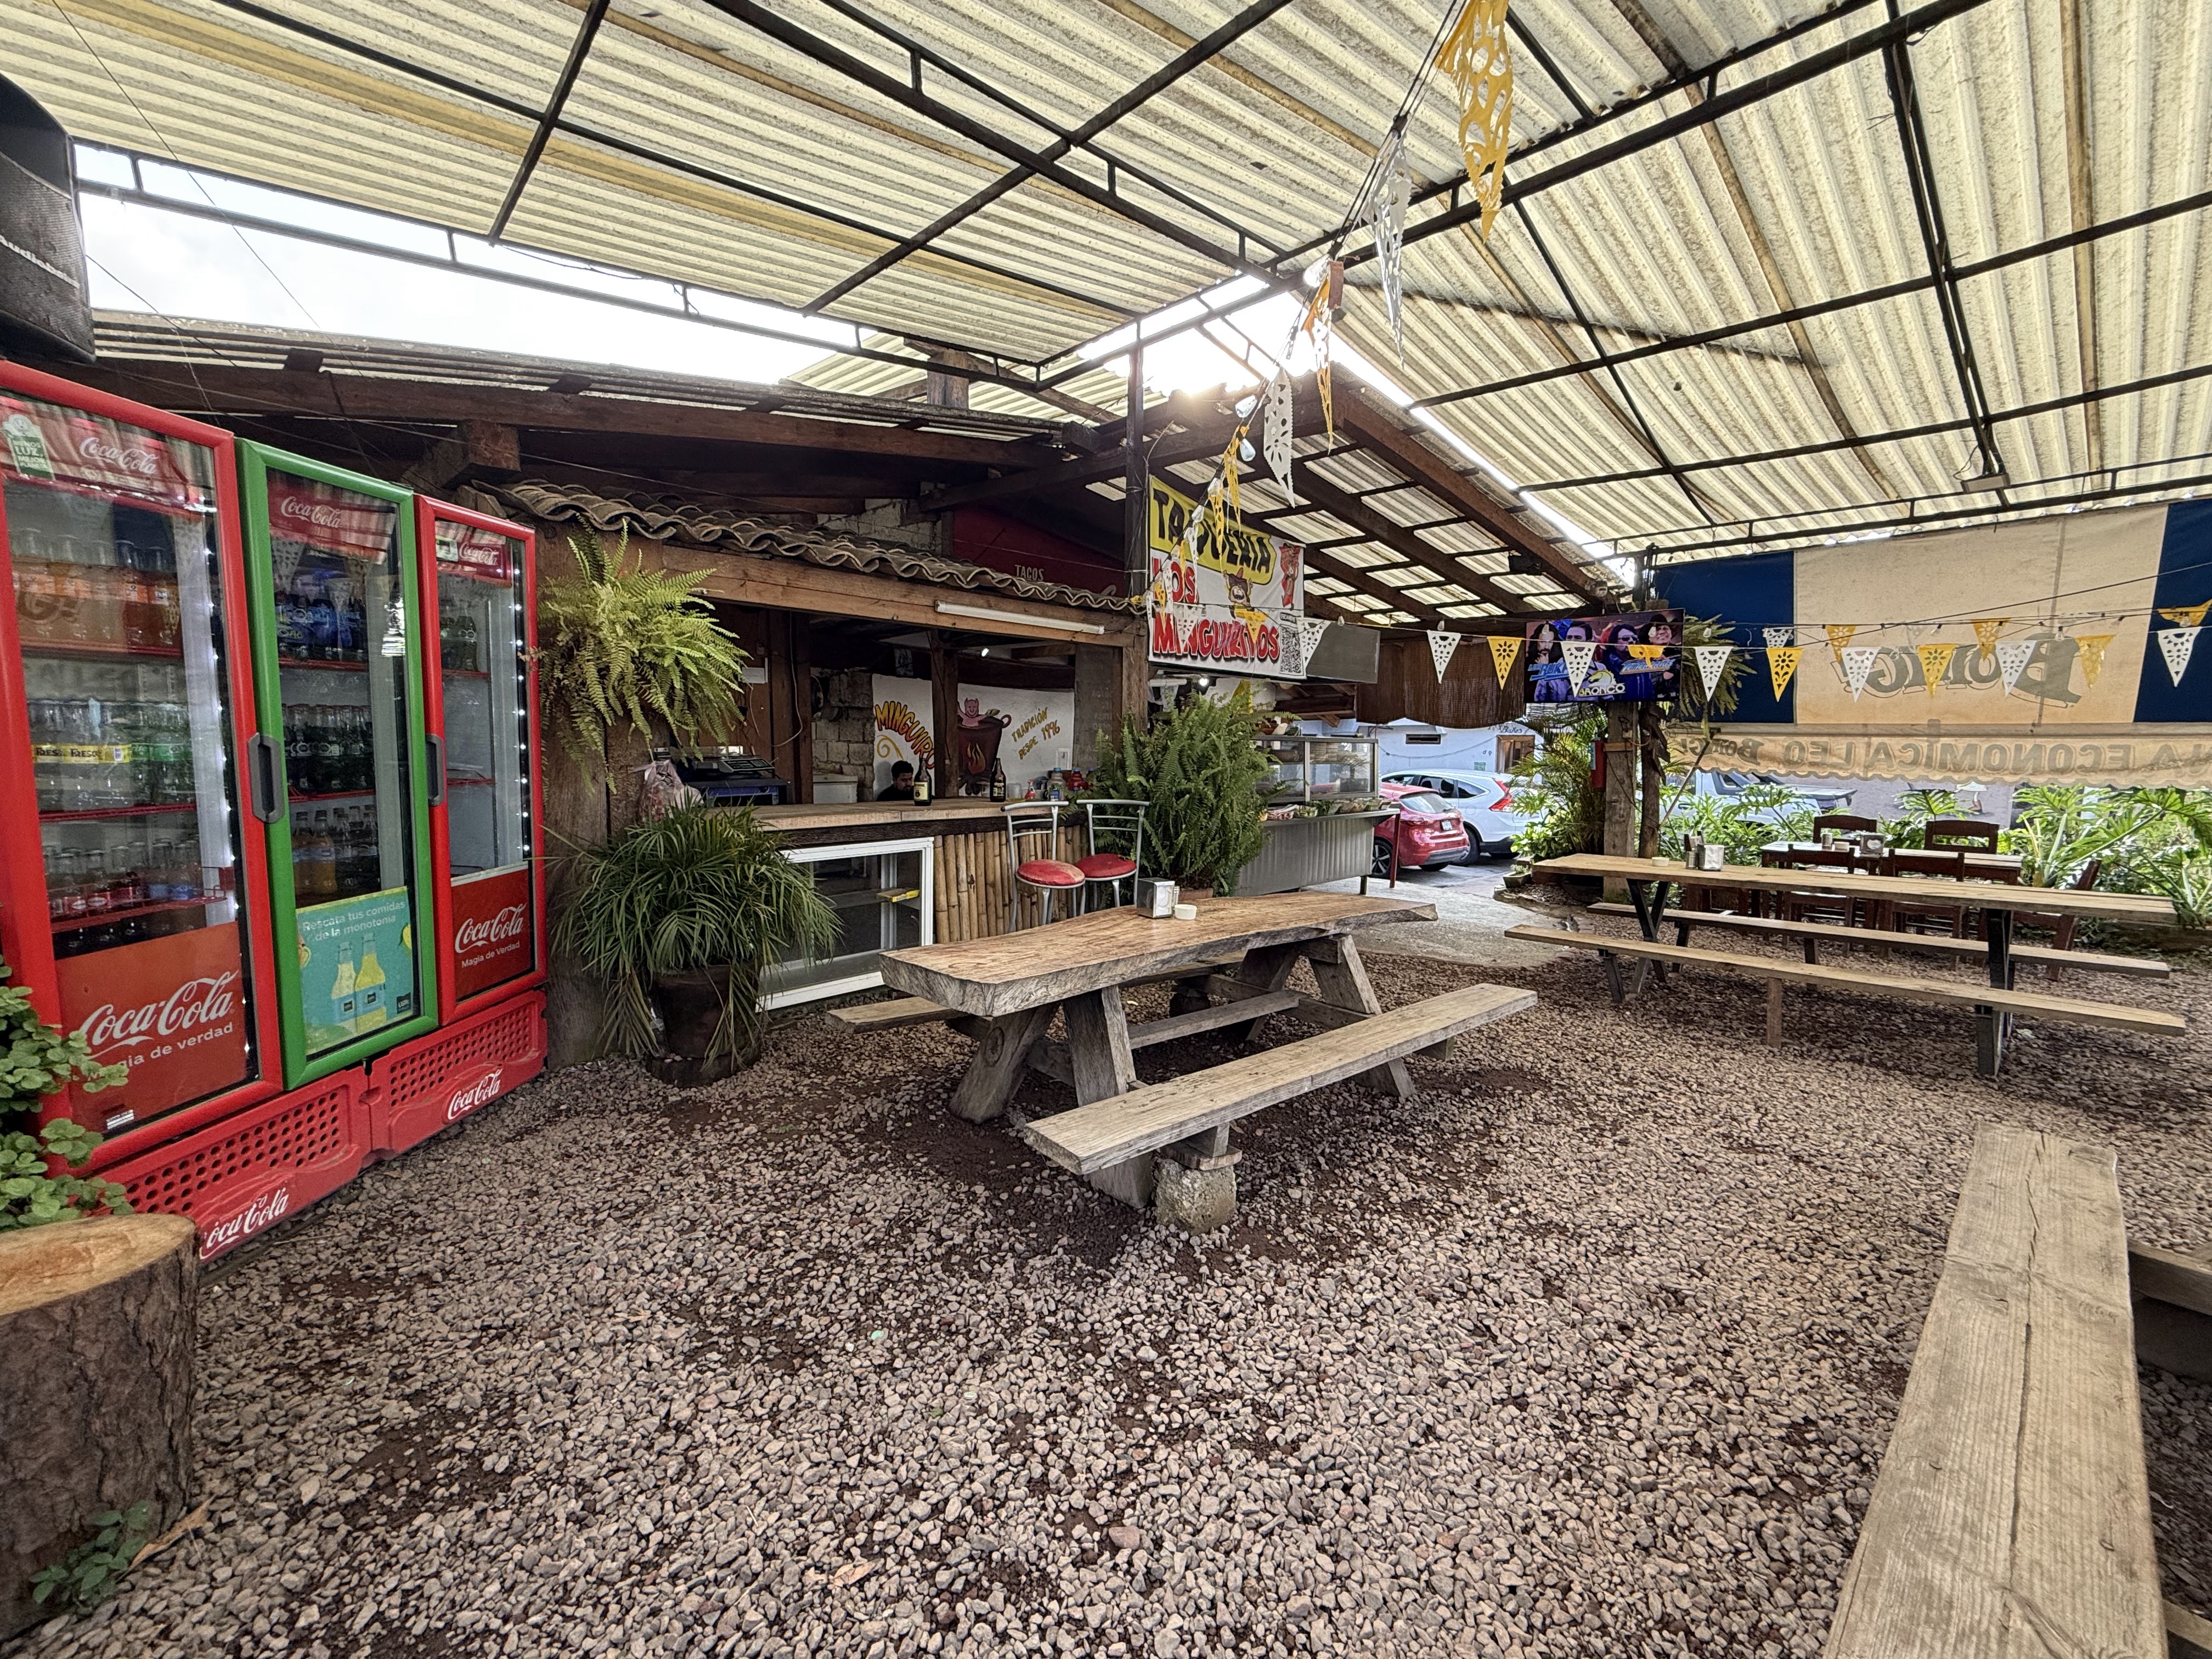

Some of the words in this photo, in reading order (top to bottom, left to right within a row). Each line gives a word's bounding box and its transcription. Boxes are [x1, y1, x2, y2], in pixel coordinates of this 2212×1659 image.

[80, 437, 159, 474] Coca-Cola
[281, 496, 343, 528] Coca-Cola
[460, 542, 499, 566] Coca-Cola
[1014, 564, 1044, 581] TACOS
[1579, 684, 1626, 696] BRONCO
[1012, 707, 1048, 742] TRADICIÓN
[1018, 735, 1039, 760] DESDE
[1041, 719, 1060, 741] 1996
[302, 915, 346, 932] Rescata
[348, 911, 364, 921] tus
[366, 901, 405, 916] comidas
[455, 902, 527, 953] Coca-Cola
[315, 932, 330, 942] de
[331, 928, 341, 938] la
[461, 955, 484, 968] Magia
[486, 951, 495, 959] de
[496, 940, 520, 955] Verdad
[79, 969, 239, 1060] Coca-Cola
[87, 1054, 145, 1081] Mia
[150, 1045, 173, 1059] de
[177, 1022, 234, 1049] verdad
[448, 1068, 503, 1120] Coca-Cola
